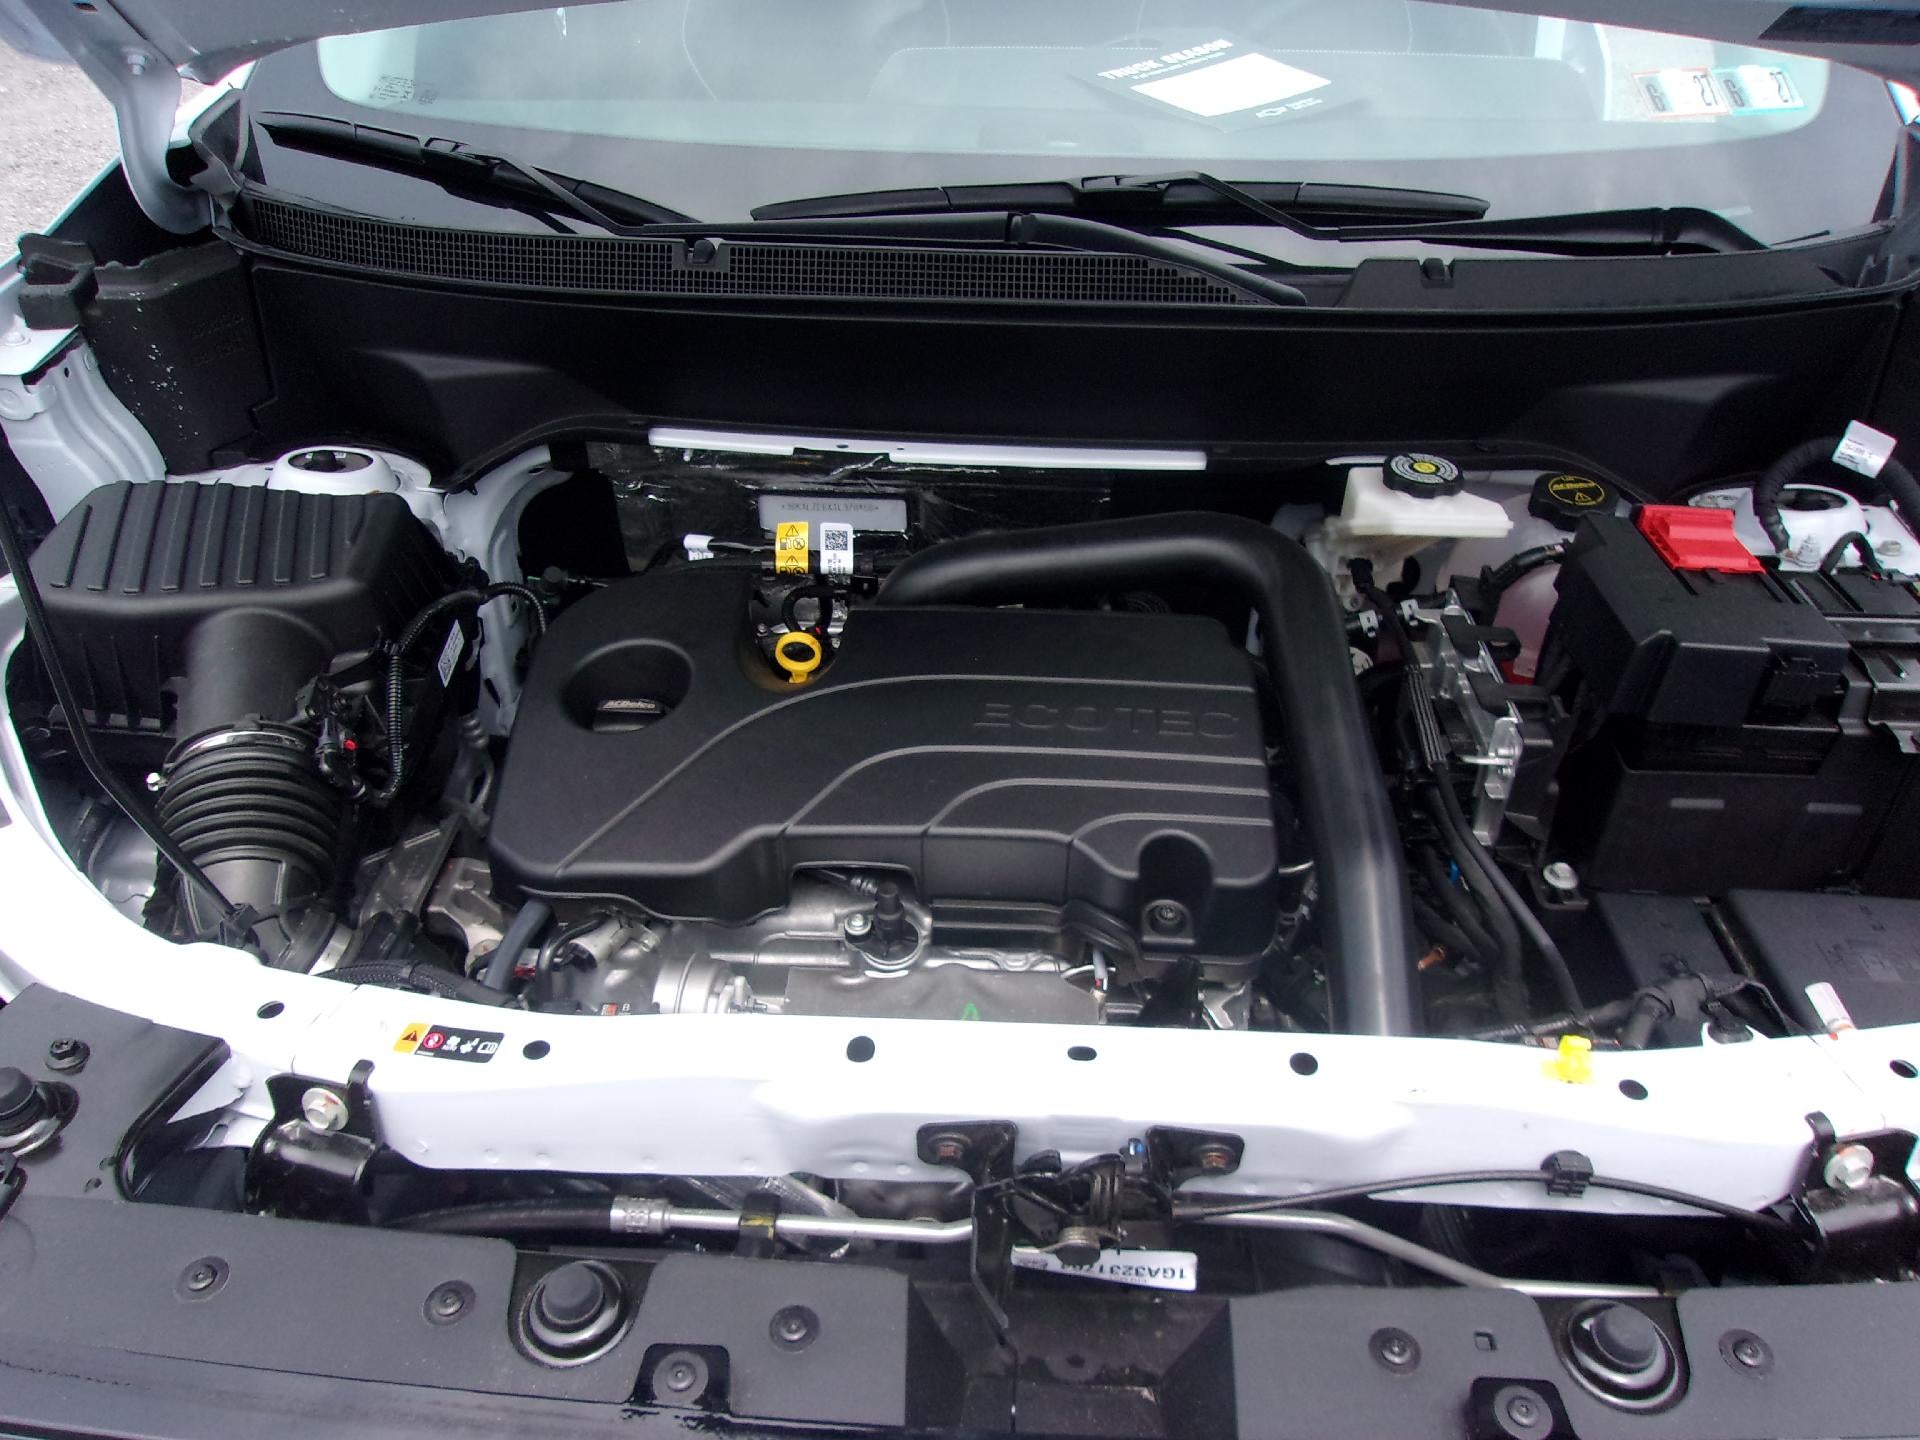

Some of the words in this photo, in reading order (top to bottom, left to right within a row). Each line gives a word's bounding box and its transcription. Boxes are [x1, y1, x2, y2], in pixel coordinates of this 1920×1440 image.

[1096, 59, 1164, 80] TRUCK
[1160, 39, 1233, 64] SEASON
[972, 703, 1240, 739] ECOTEC
